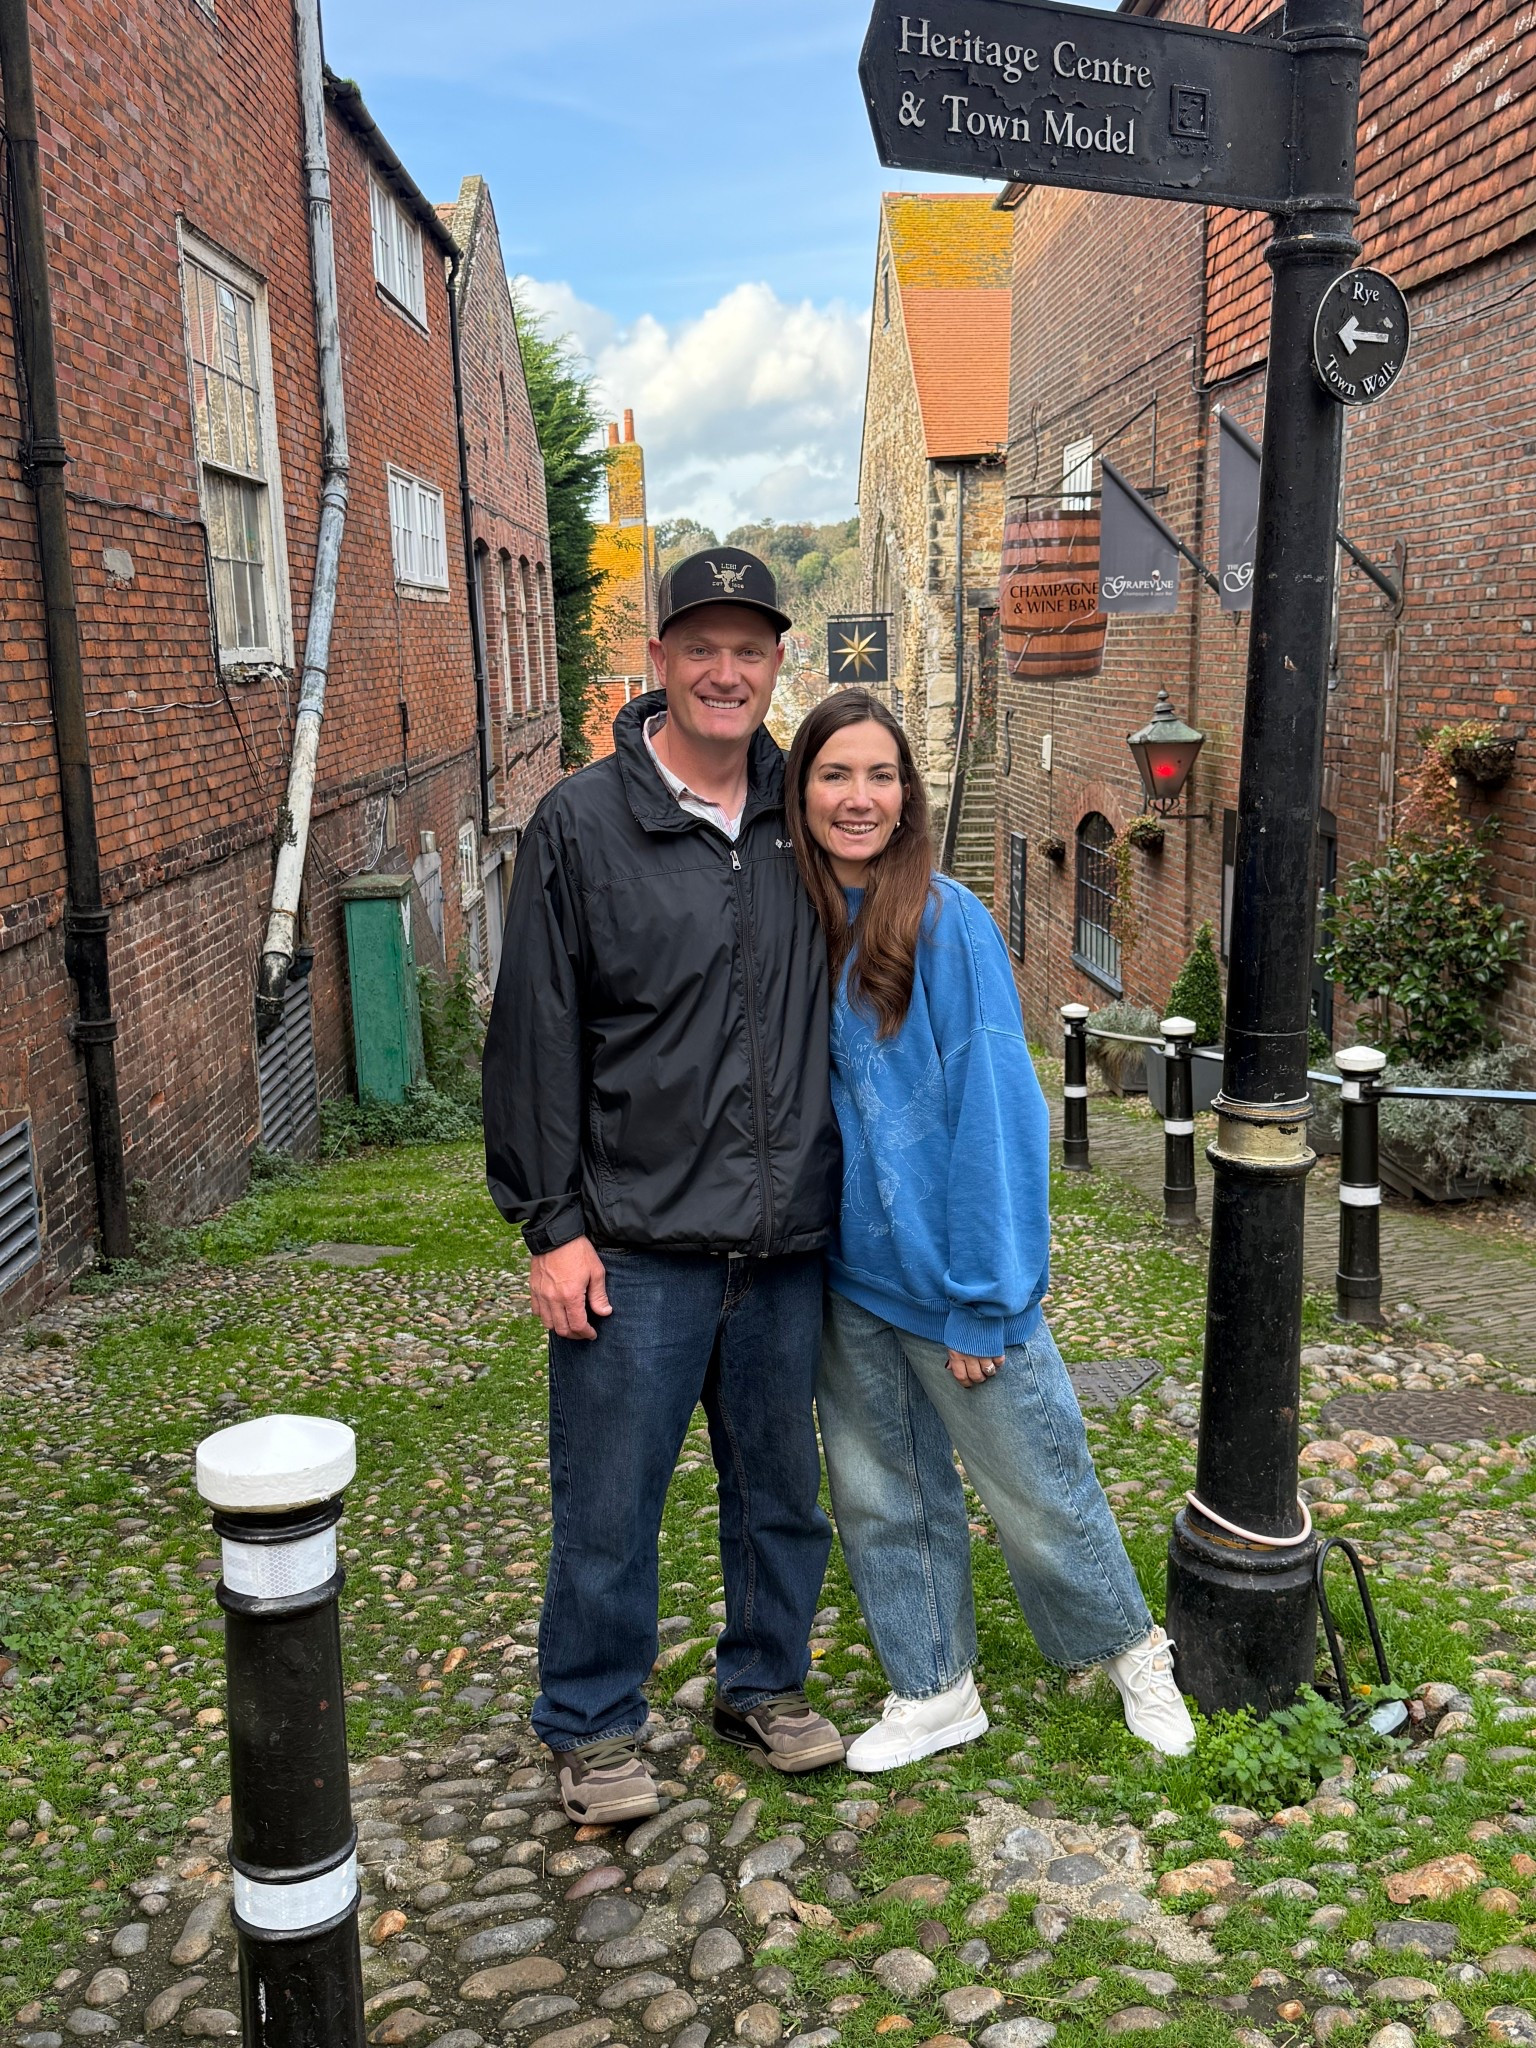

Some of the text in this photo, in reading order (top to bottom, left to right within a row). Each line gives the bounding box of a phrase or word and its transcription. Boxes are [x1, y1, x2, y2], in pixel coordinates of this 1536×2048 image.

[899, 15, 1152, 88] Heritage Centre
[898, 90, 1135, 155] & Town Model
[1353, 281, 1380, 306] Rye
[1325, 354, 1398, 396] Town Walk
[1010, 582, 1099, 599] CHAMPAGNE
[1101, 571, 1174, 599] GRAPEVINE
[1013, 598, 1096, 615] & WINE BAR
